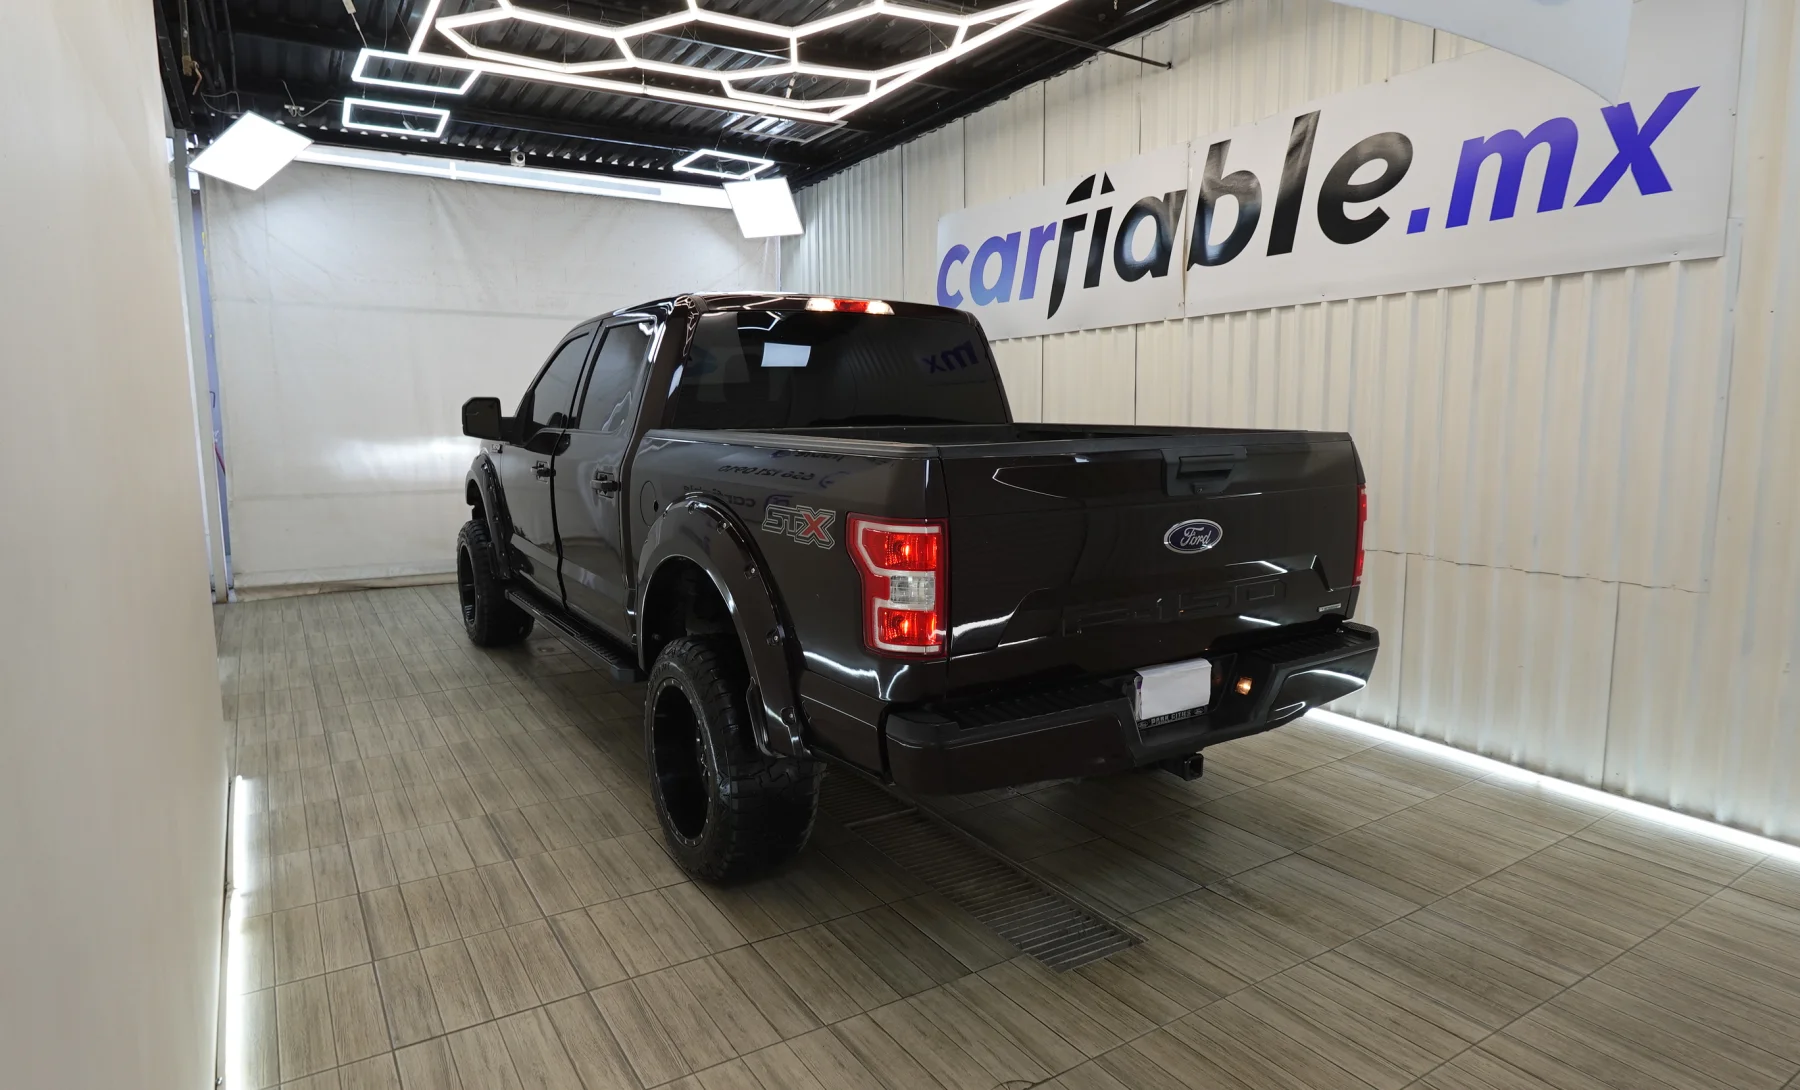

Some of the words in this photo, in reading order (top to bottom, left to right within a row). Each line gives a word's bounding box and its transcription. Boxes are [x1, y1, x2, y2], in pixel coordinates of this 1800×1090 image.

[936, 86, 1701, 321] carfiable.mx
[761, 503, 836, 550] STX
[1179, 526, 1212, 547] Ford
